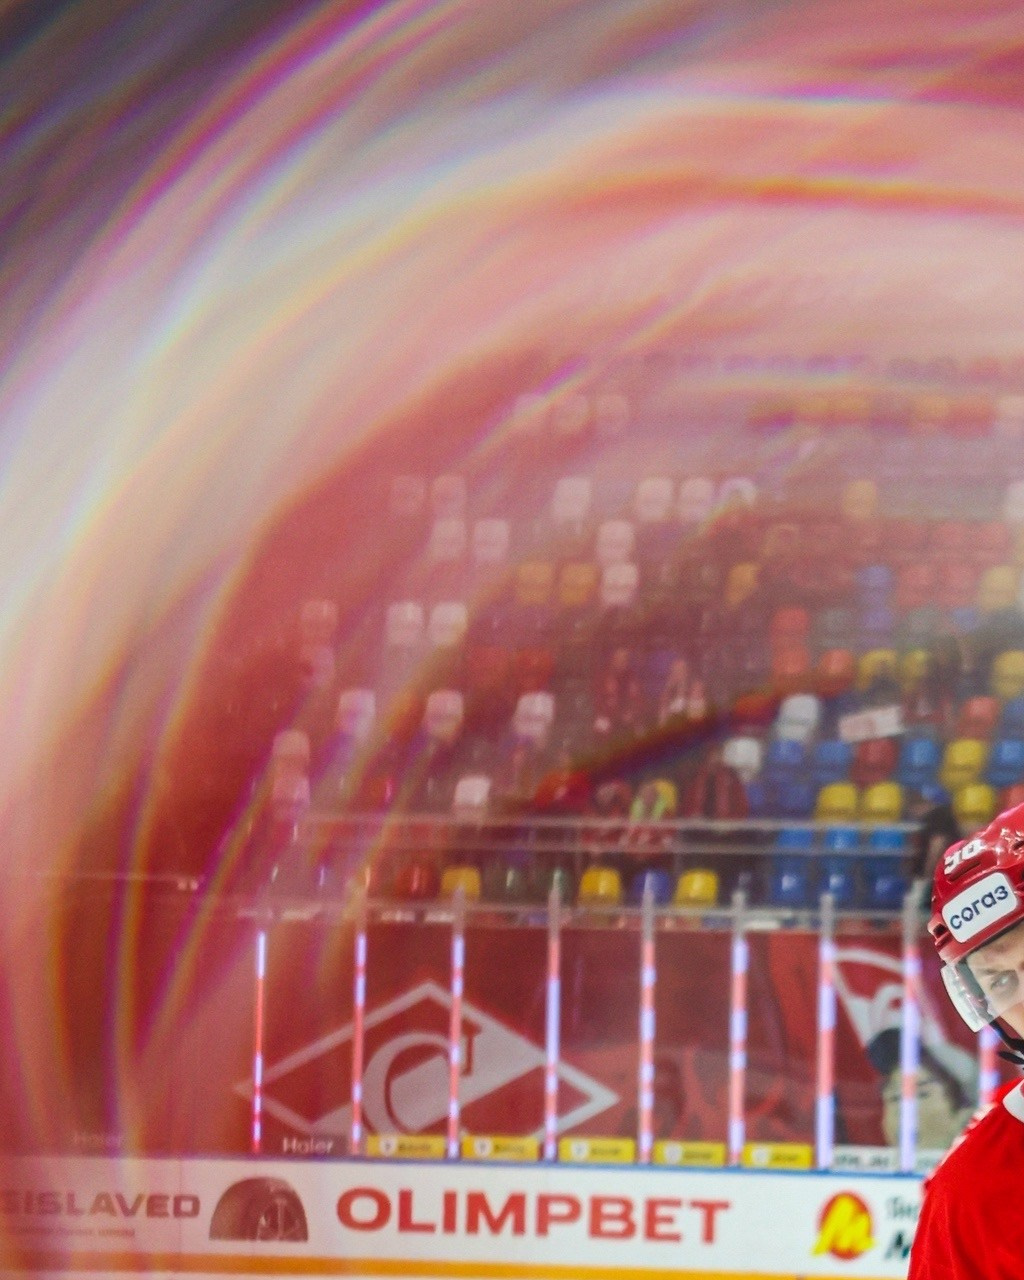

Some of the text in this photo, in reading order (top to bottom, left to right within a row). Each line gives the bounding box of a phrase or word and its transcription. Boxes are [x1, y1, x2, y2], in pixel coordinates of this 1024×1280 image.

[950, 885, 1009, 930] согаз
[282, 1137, 333, 1153] Haier
[336, 1186, 730, 1244] OLIMPBET
